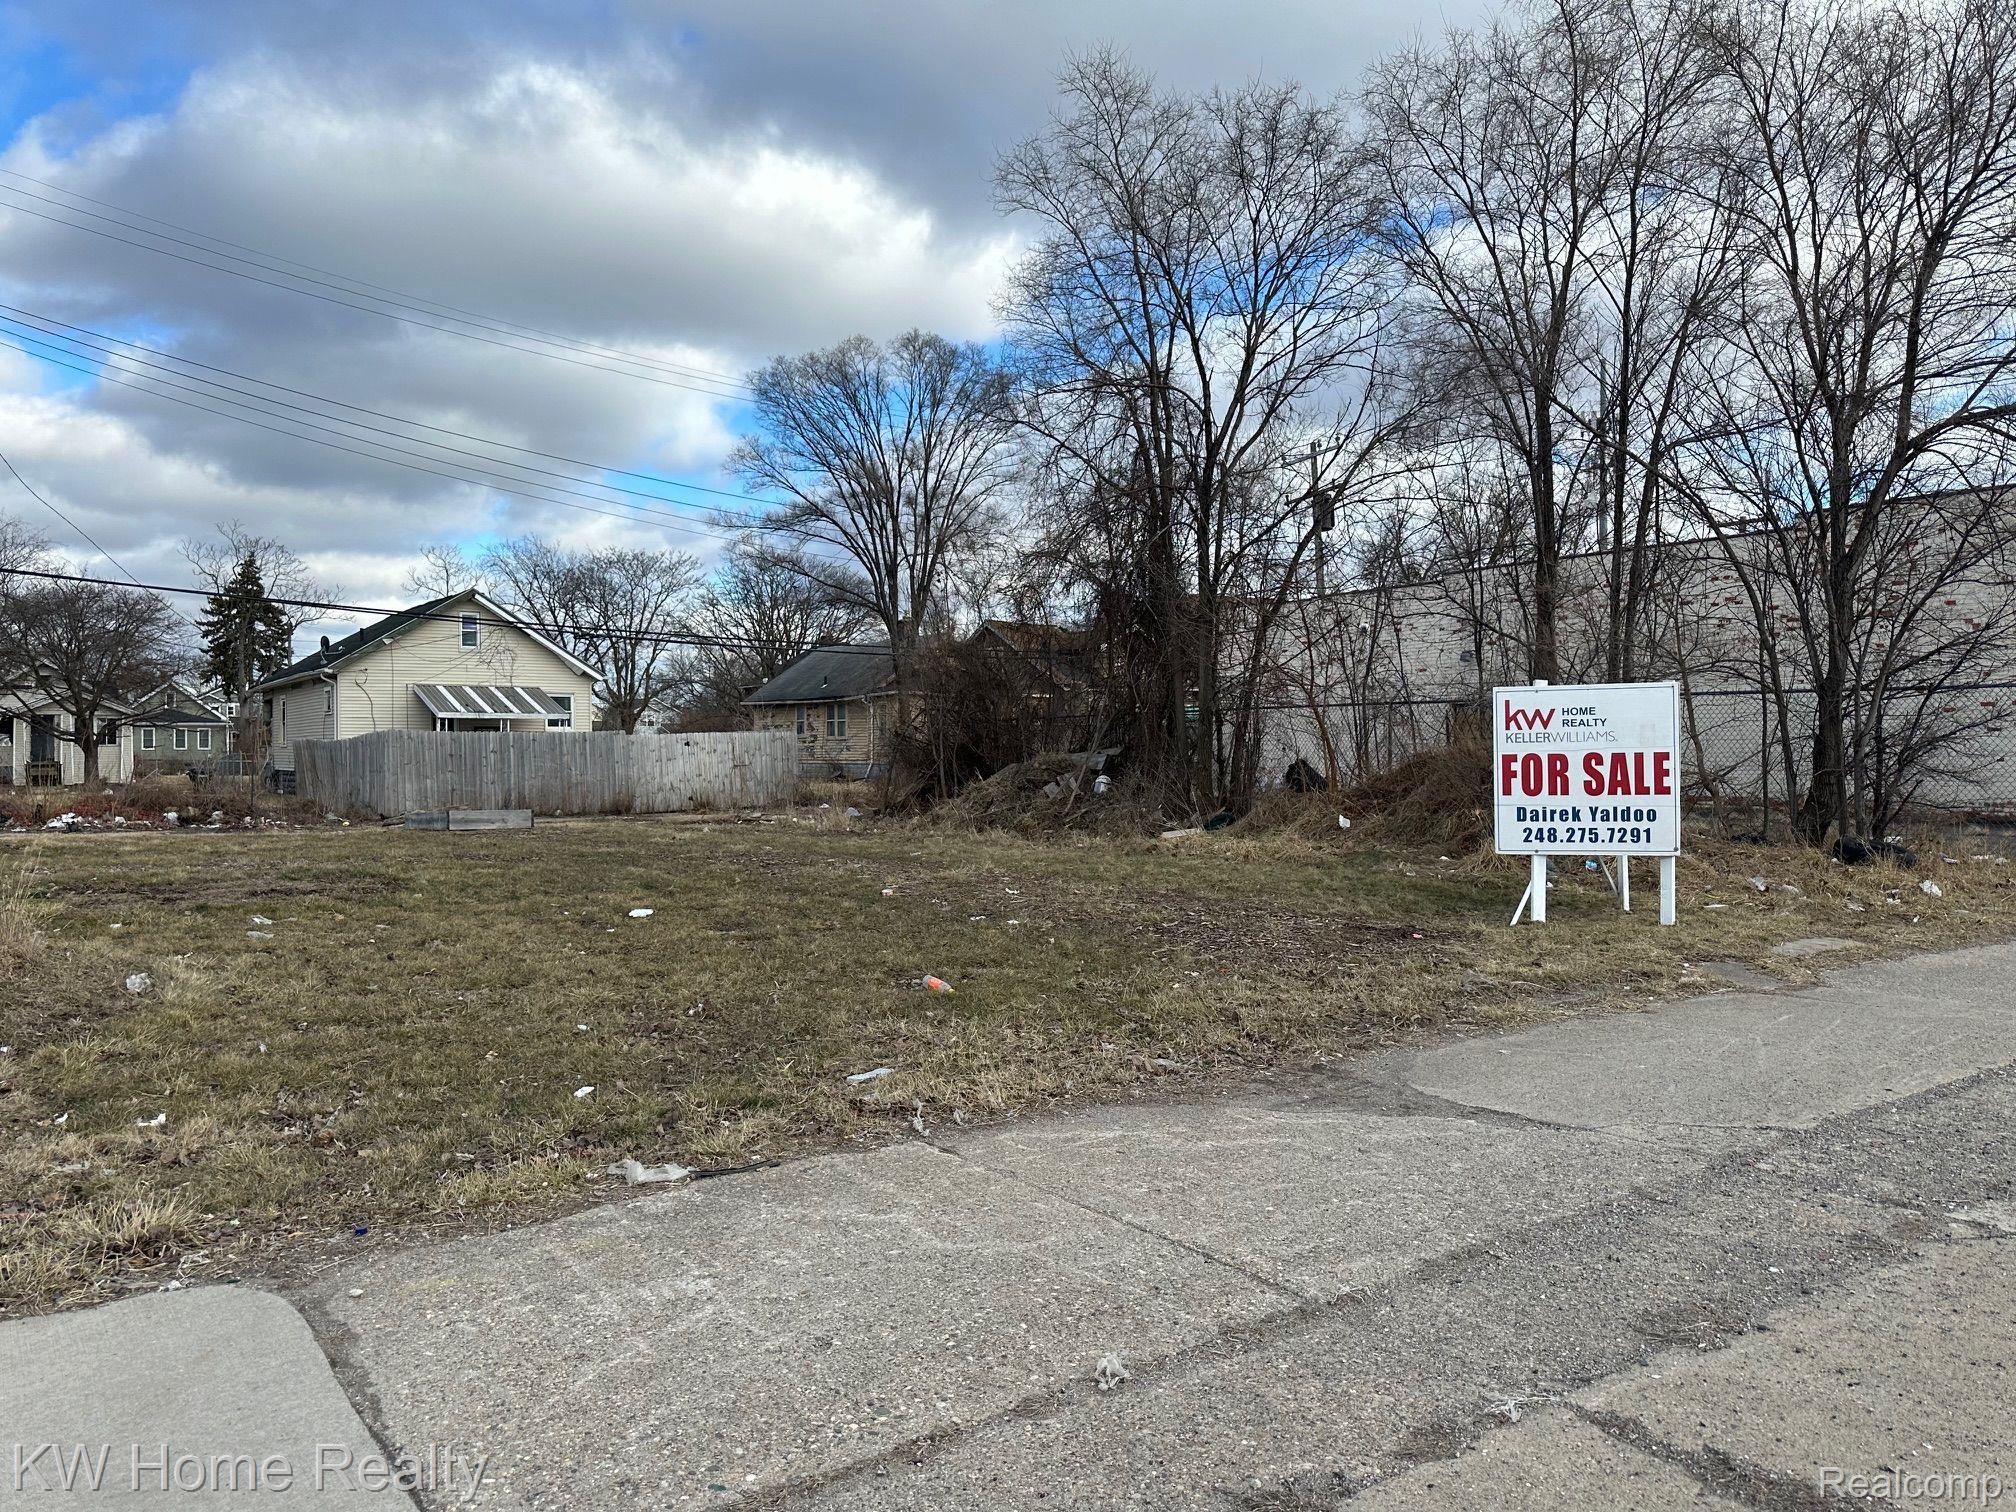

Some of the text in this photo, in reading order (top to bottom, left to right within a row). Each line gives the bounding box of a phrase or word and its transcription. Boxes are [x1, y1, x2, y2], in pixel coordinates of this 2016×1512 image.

[1505, 700, 1555, 730] kw
[1562, 707, 1596, 716] HOME
[1562, 718, 1607, 727] REALTY
[1501, 752, 1671, 797] FOR SALE
[1516, 806, 1657, 822] Dairek Yaldoo
[1522, 827, 1651, 843] 248.275.7291
